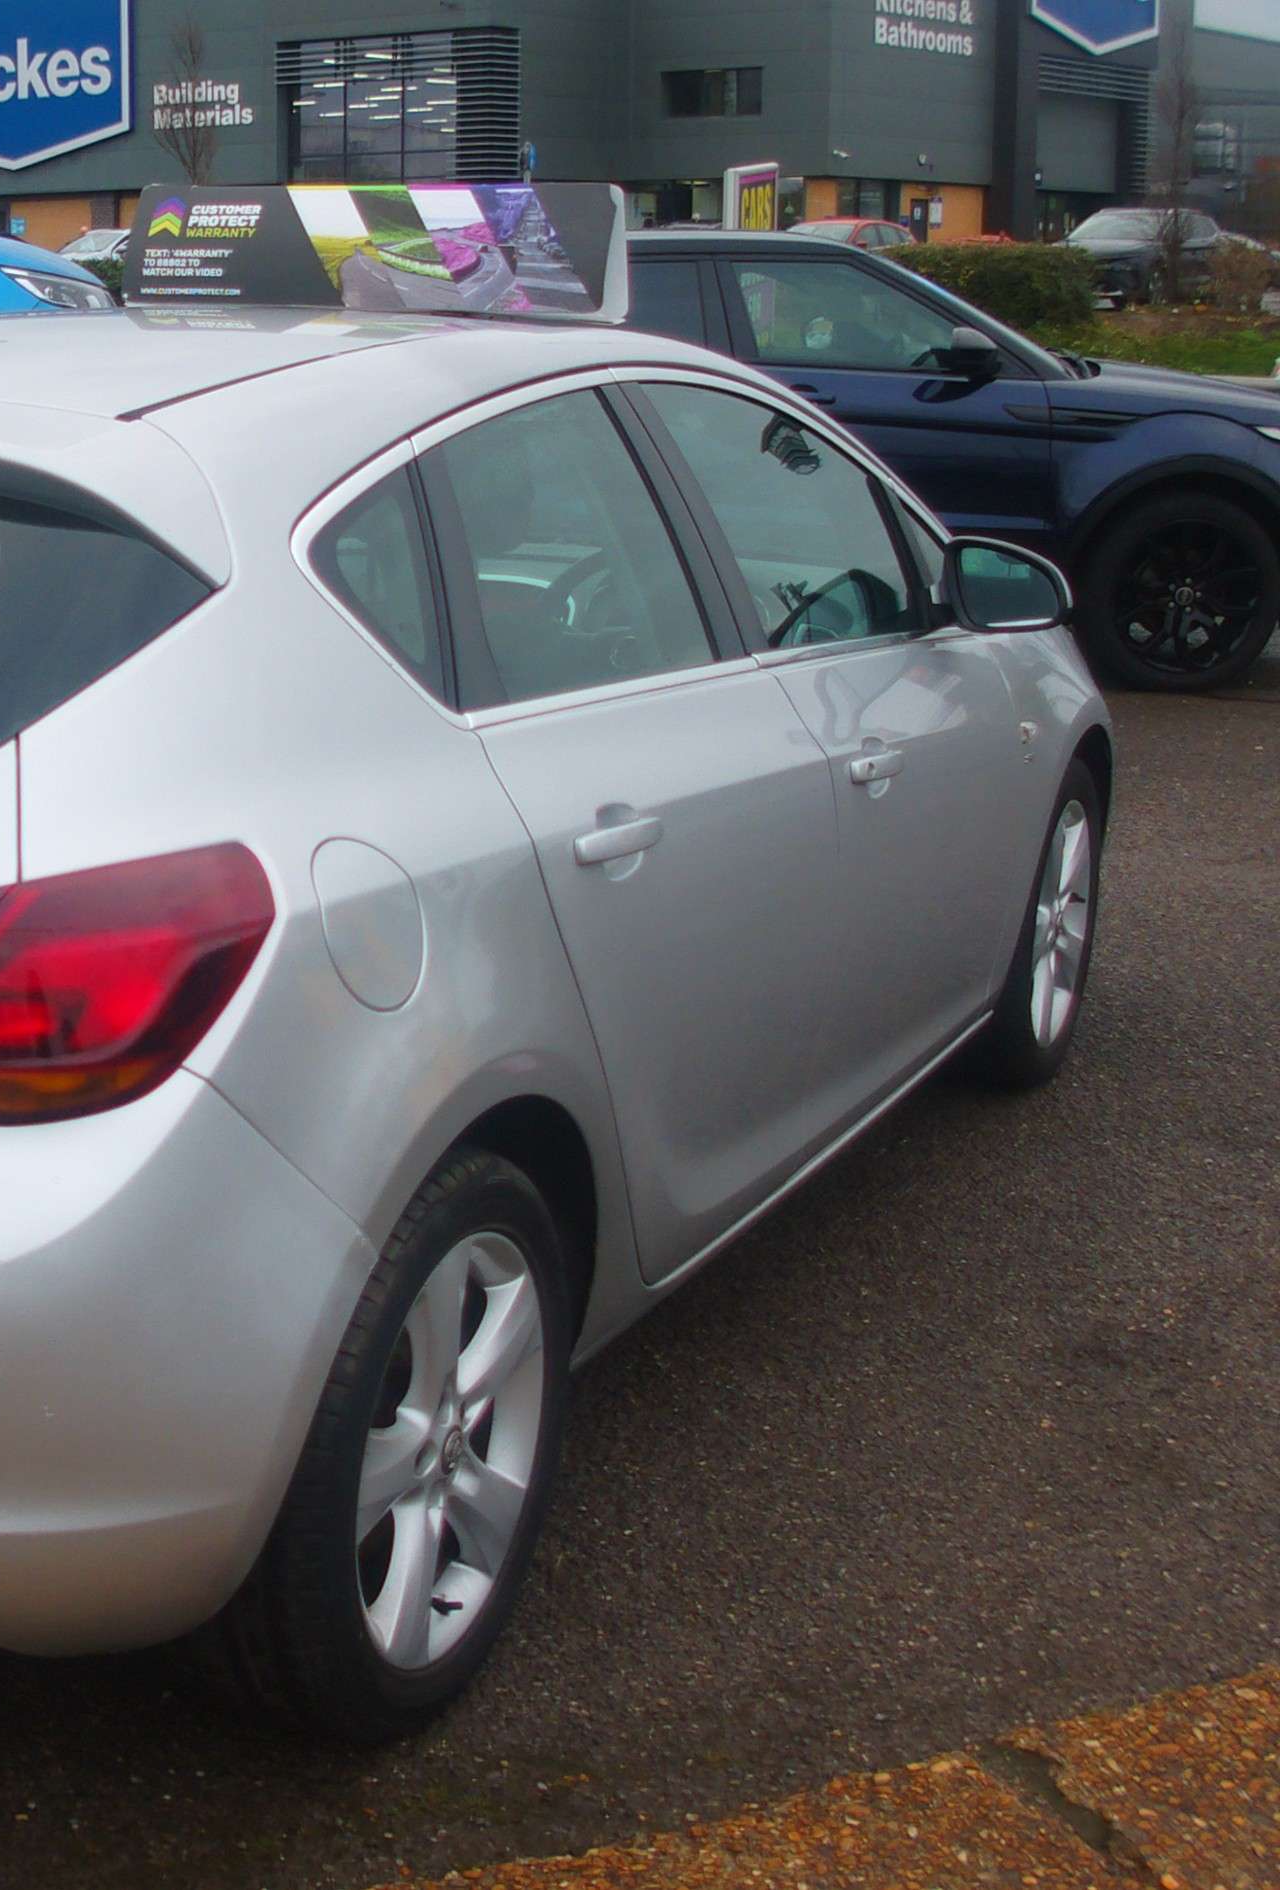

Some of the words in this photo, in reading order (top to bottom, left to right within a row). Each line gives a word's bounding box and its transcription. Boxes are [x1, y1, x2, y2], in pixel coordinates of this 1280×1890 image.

[959, 0, 972, 25] &
[874, 17, 973, 56] Bathrooms
[153, 80, 239, 105] Building
[153, 104, 253, 130] Materials
[191, 205, 261, 215] CUSTOMER
[187, 215, 259, 227] PROTECT
[186, 228, 256, 238] WARRANTY
[144, 258, 155, 267] TO
[188, 258, 200, 267] TO
[142, 268, 175, 277] WATCH
[174, 268, 194, 277] OUR
[195, 268, 223, 277] VIDEO
